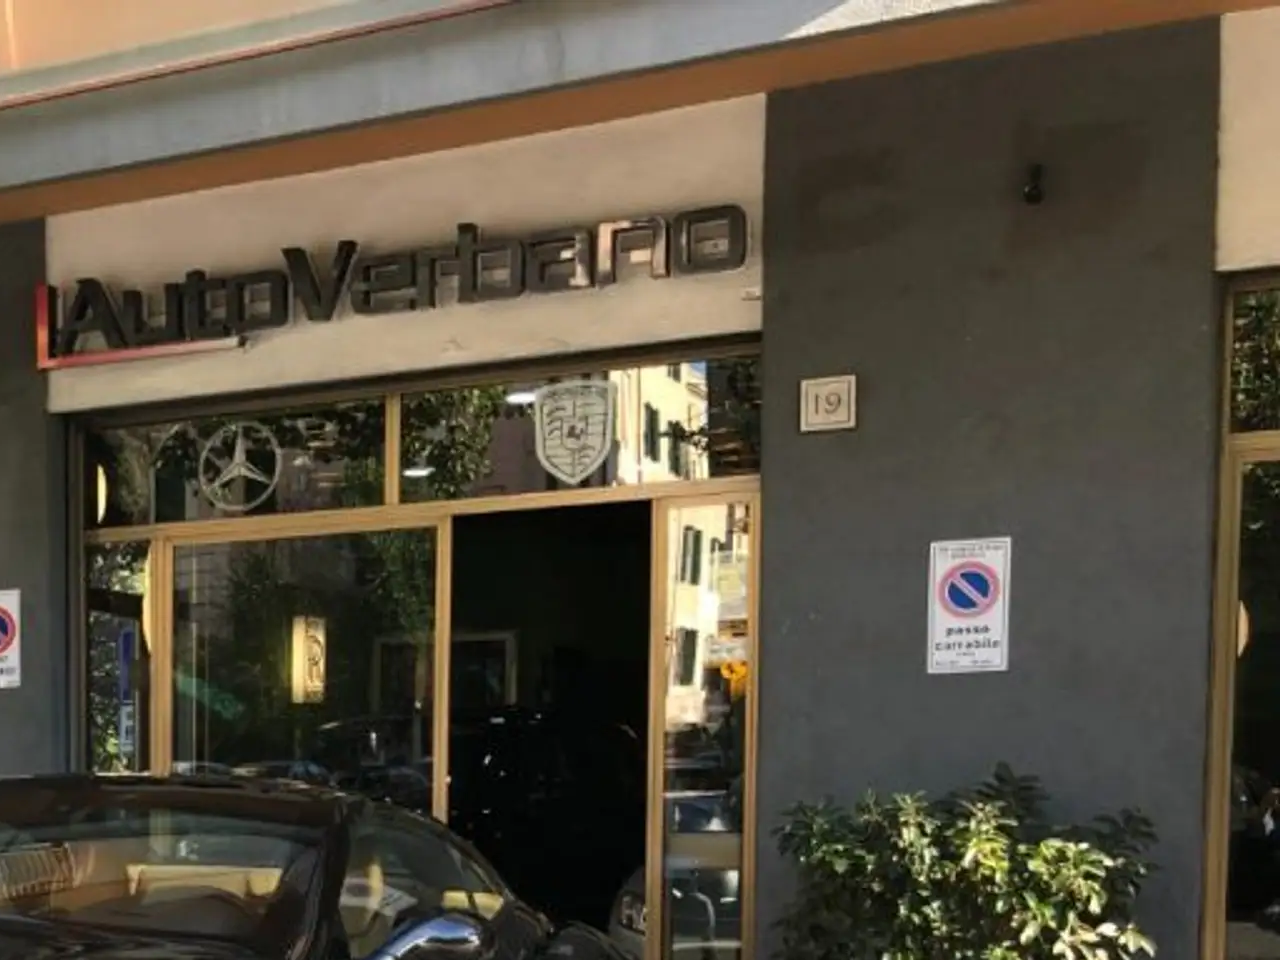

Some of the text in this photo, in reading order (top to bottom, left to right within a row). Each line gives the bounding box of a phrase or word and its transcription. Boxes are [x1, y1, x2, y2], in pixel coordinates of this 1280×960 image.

[54, 203, 748, 358] AutoVerbano
[814, 391, 842, 416] 19
[945, 624, 991, 638] passo
